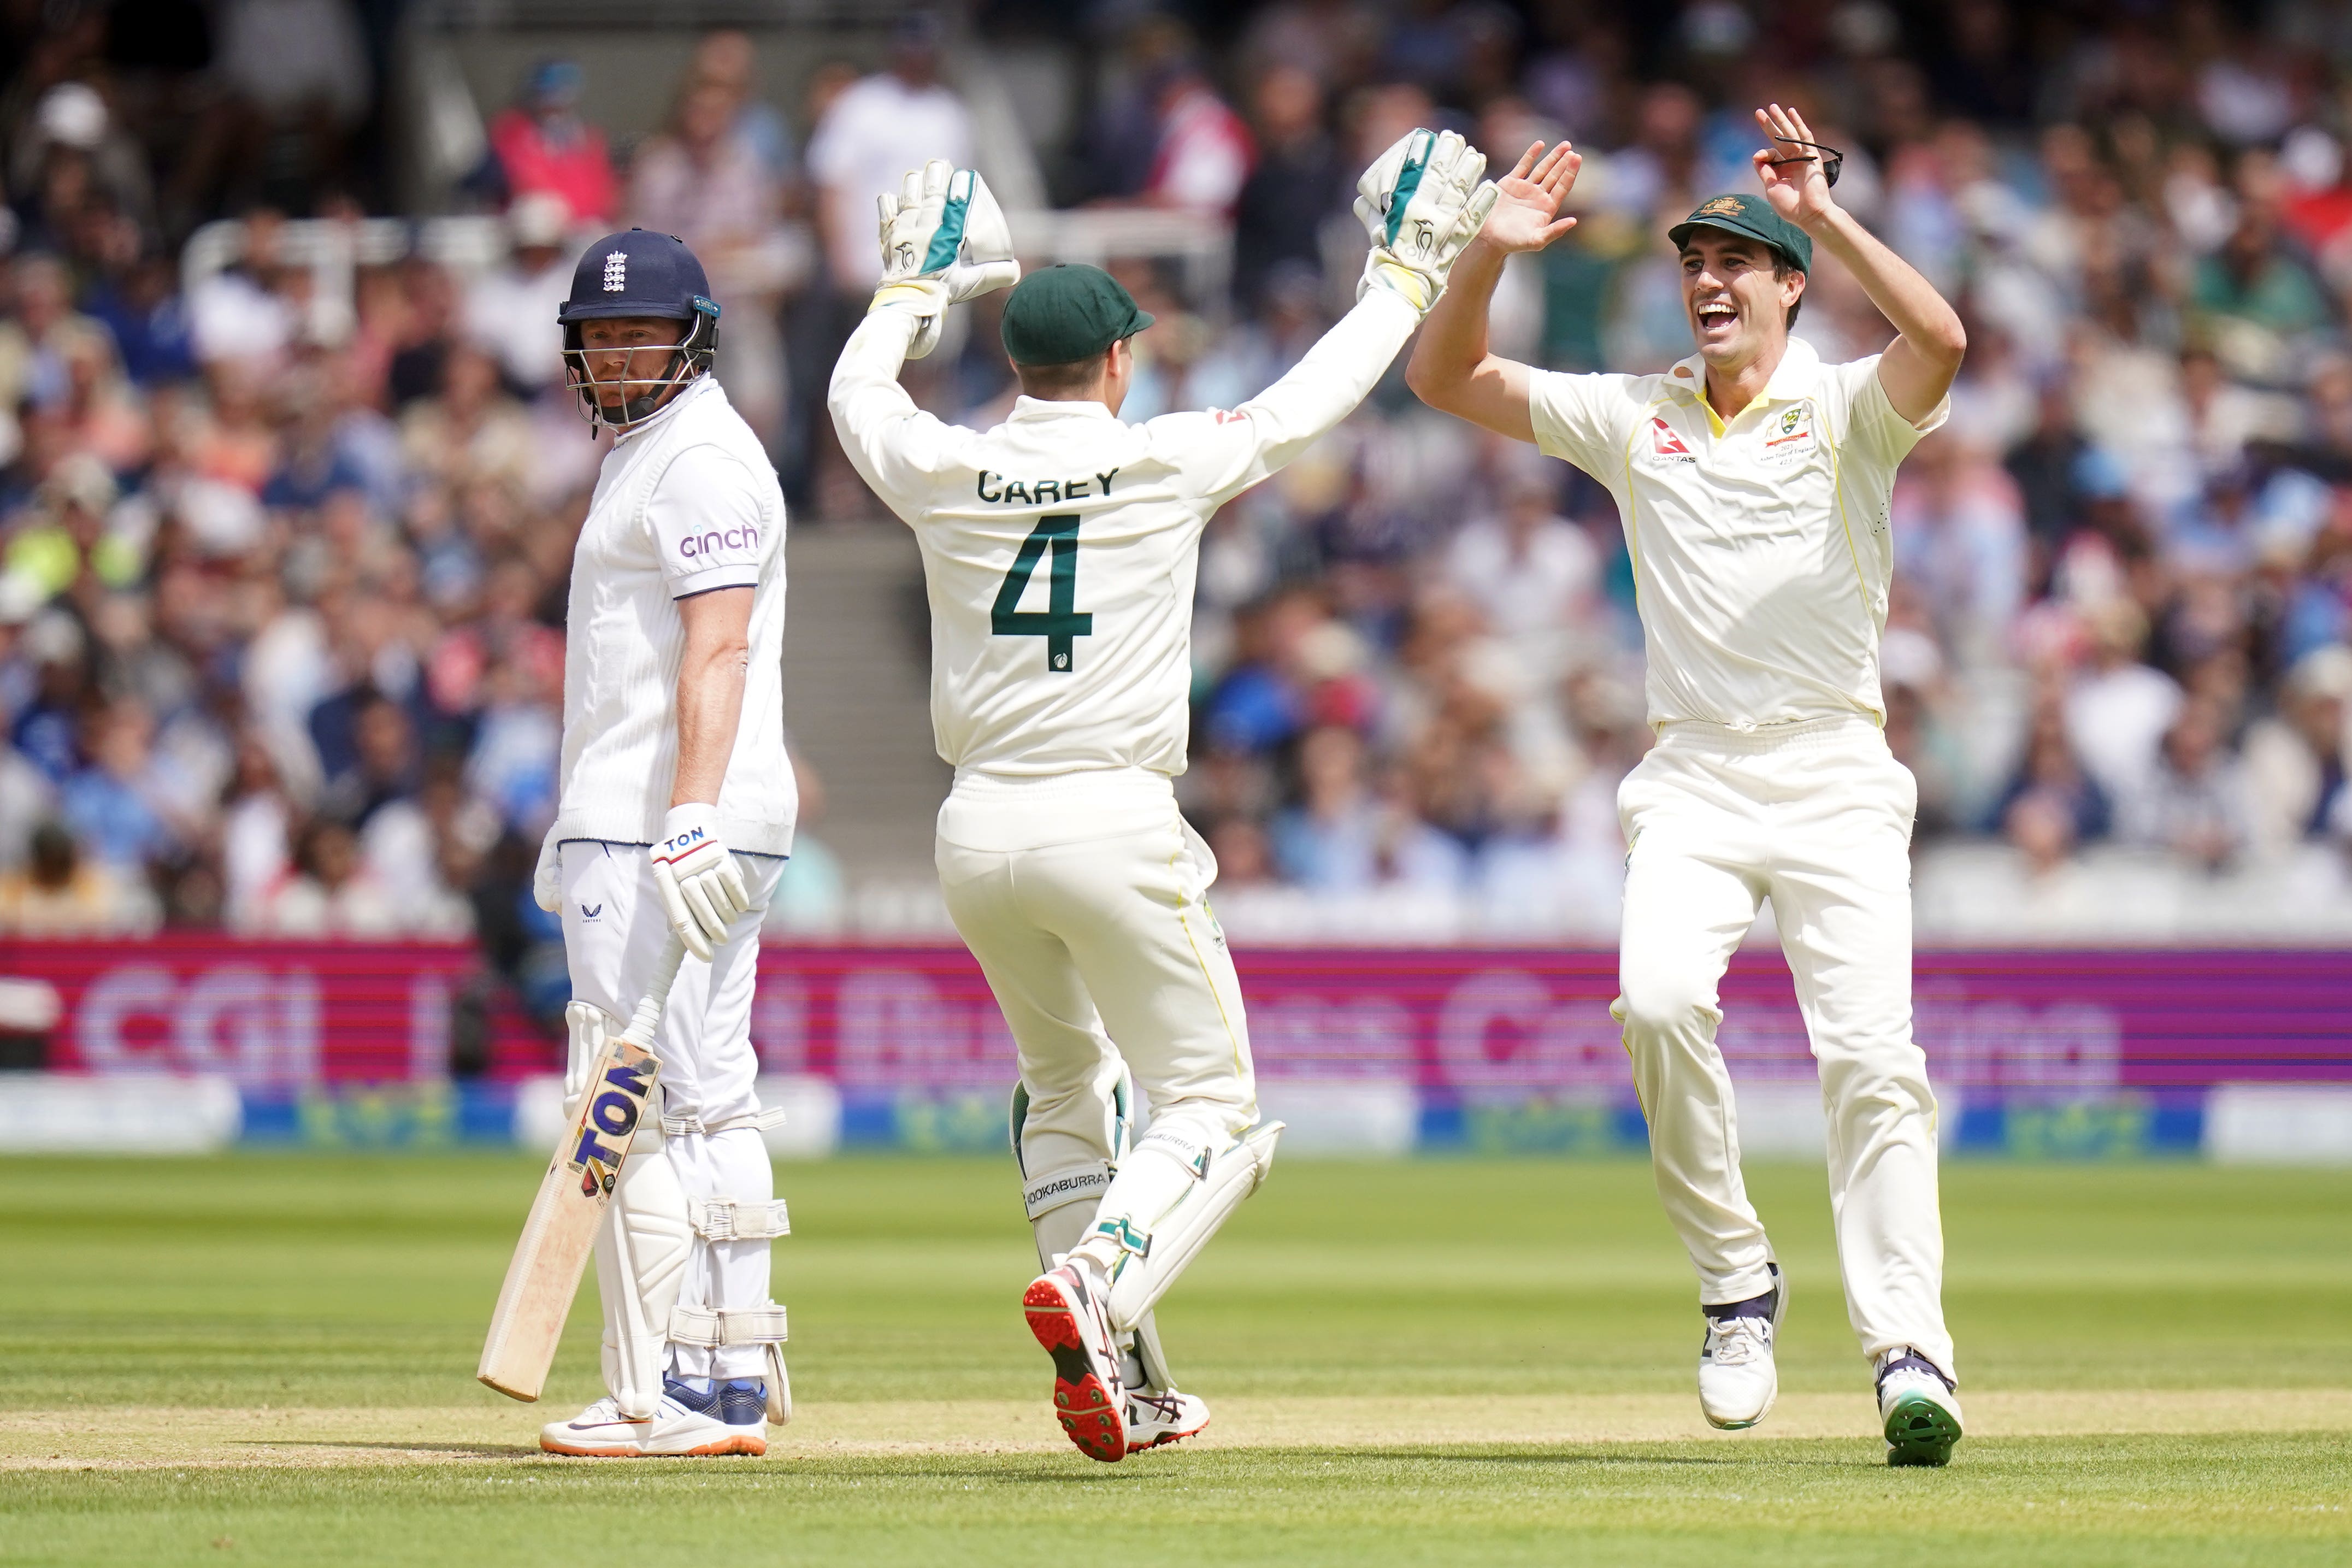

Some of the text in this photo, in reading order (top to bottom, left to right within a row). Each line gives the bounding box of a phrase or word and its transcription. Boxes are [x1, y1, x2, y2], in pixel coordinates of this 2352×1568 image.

[977, 467, 1119, 504] CAREY
[680, 524, 758, 558] cinch
[991, 514, 1093, 672] 4
[664, 826, 704, 851] TON
[574, 1058, 660, 1170] TON
